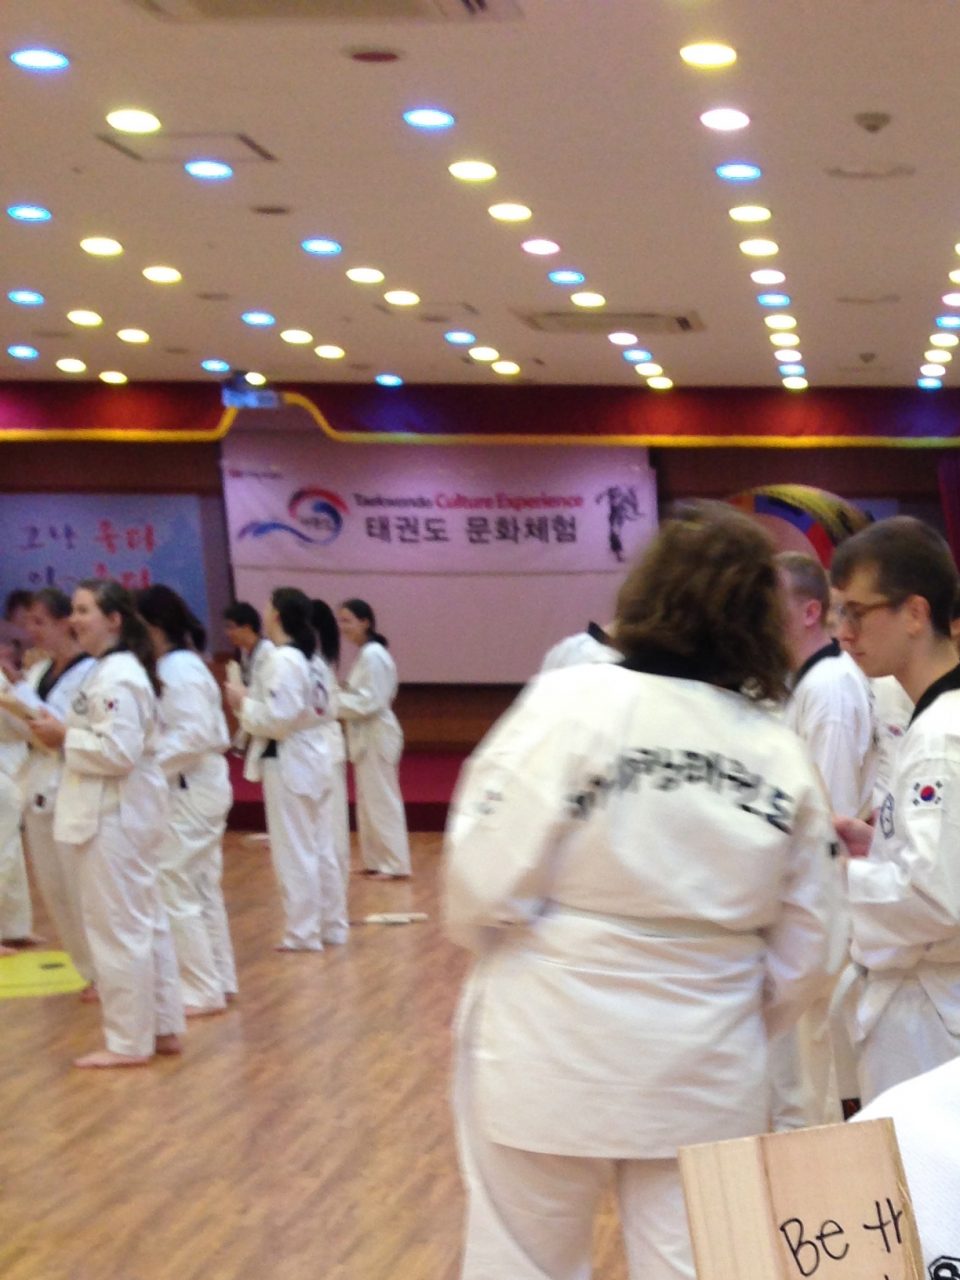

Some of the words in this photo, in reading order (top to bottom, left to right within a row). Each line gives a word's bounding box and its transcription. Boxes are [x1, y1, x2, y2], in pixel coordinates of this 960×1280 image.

[364, 515, 450, 544] 태권도
[465, 514, 578, 544] 문화체험
[779, 1217, 851, 1278] Be
